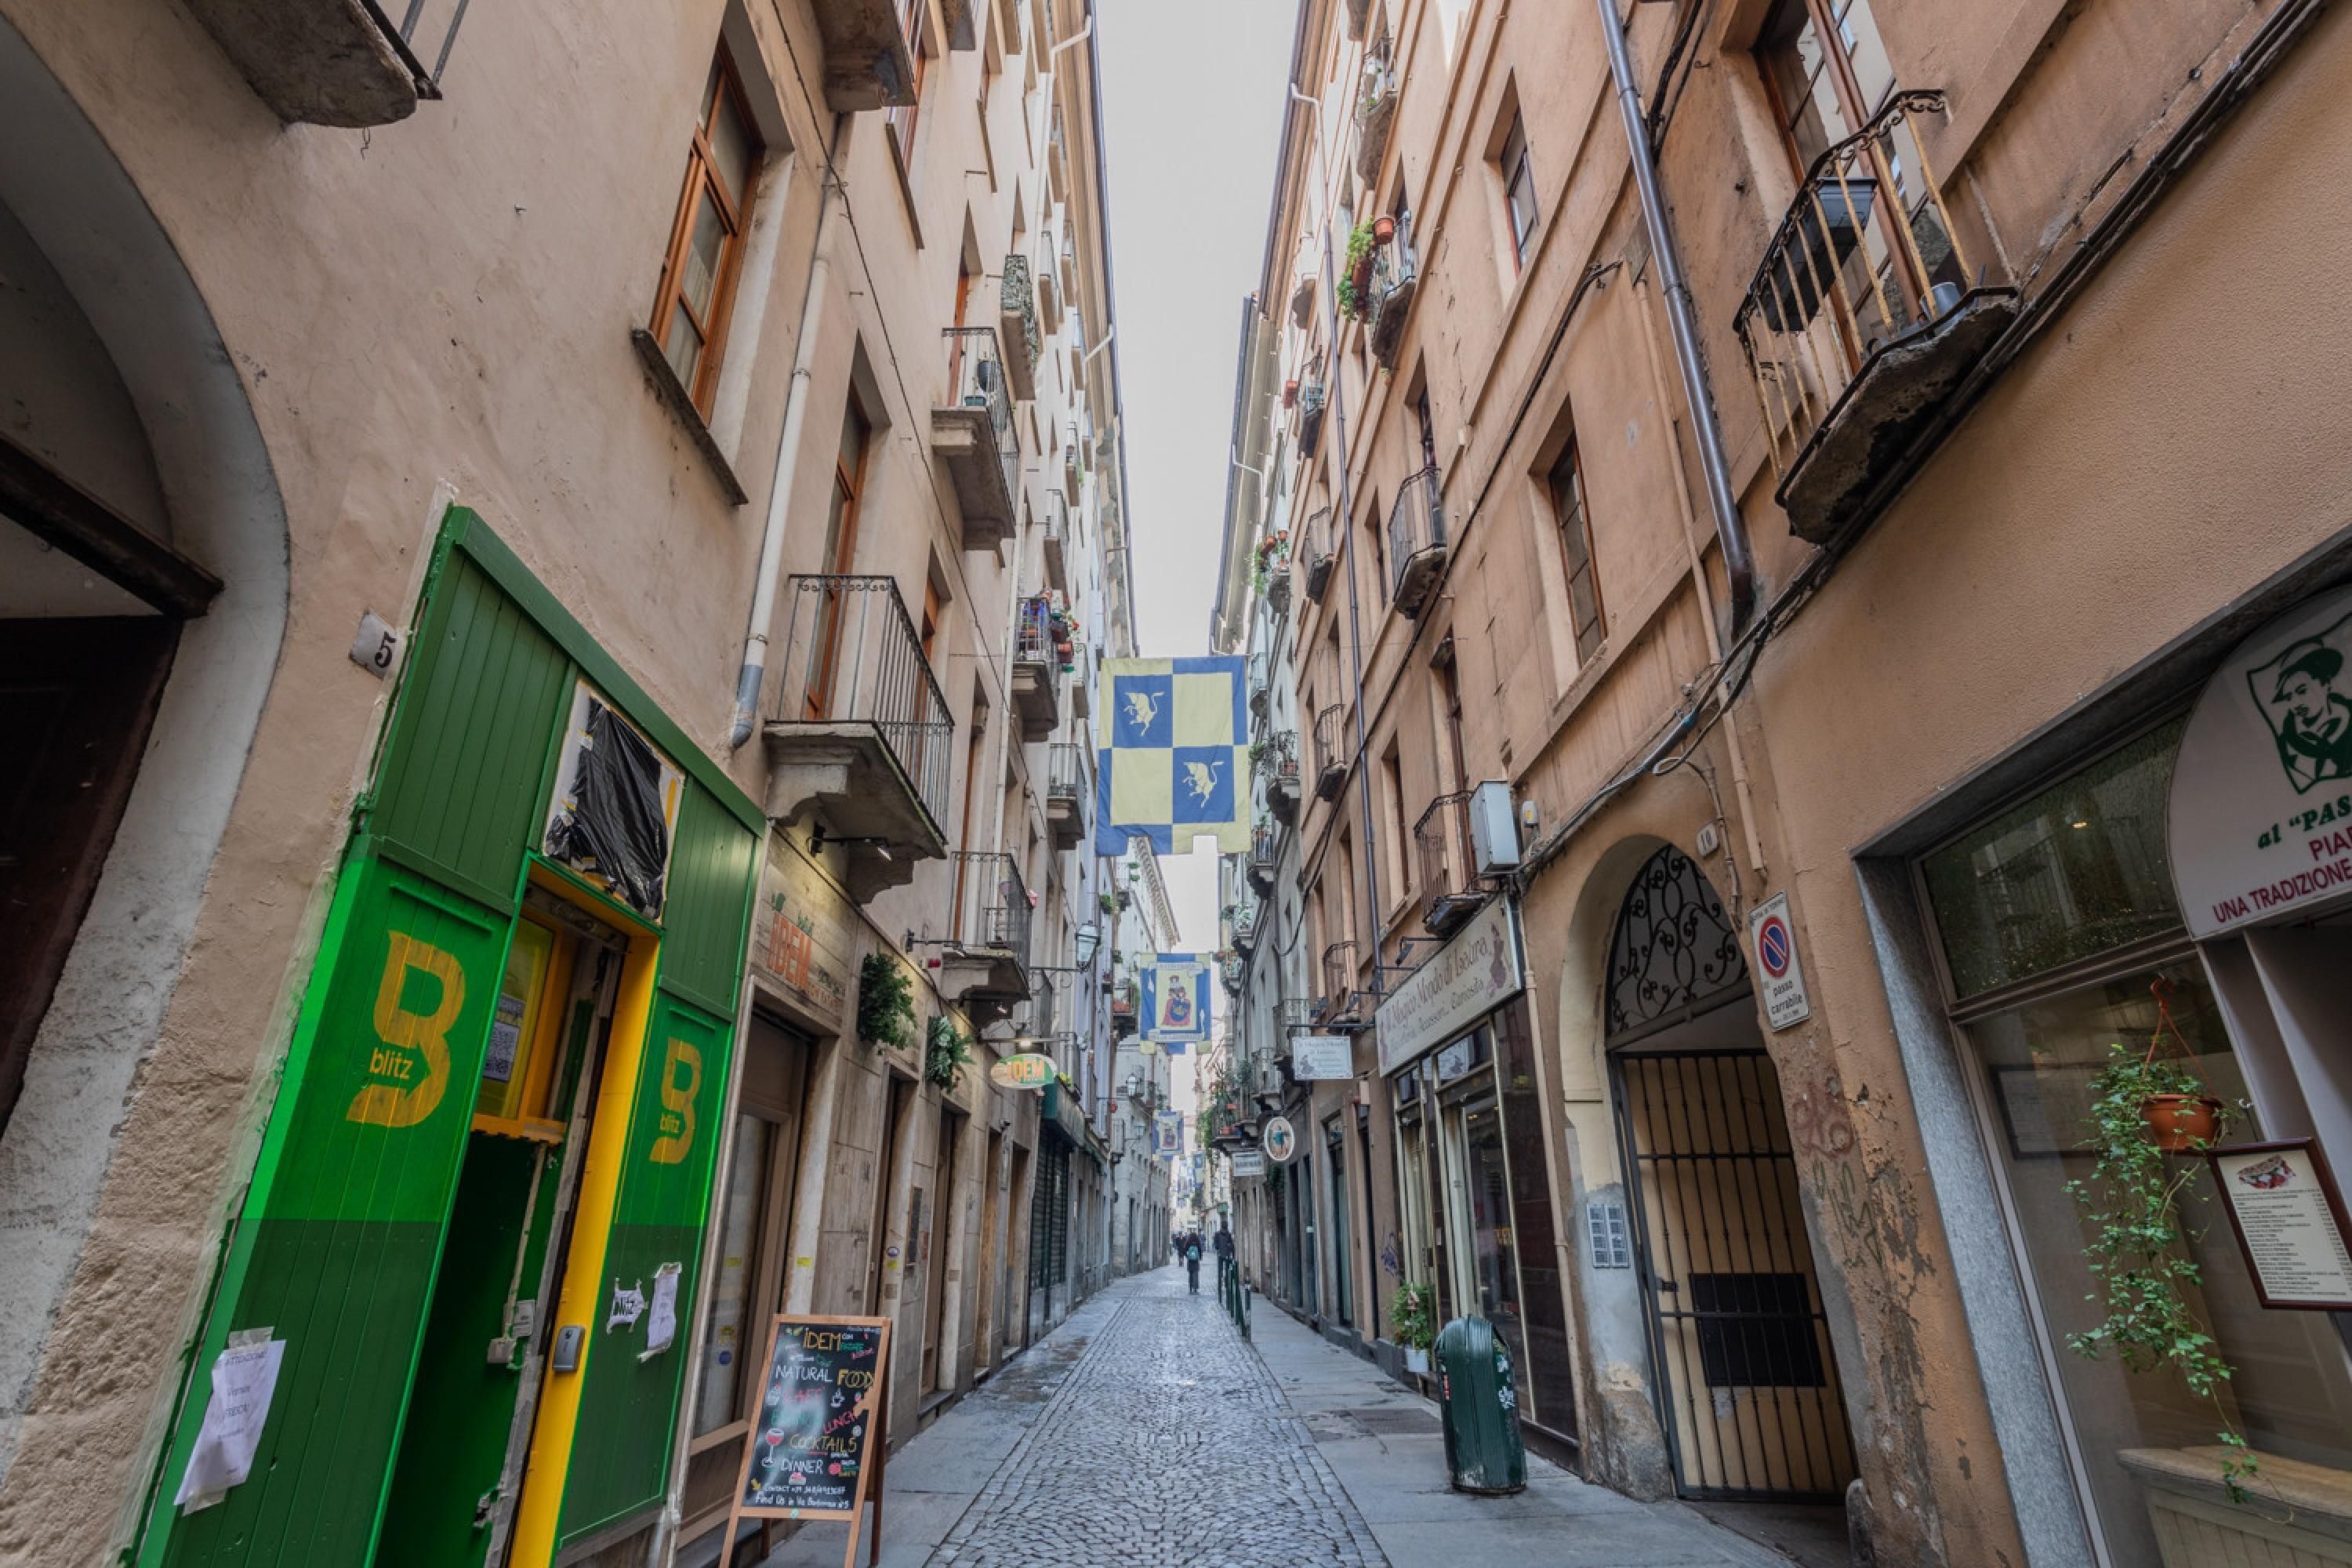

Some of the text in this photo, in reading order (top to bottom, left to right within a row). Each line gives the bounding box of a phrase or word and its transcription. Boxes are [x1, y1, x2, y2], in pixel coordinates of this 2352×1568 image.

[375, 630, 396, 668] 5
[1700, 829, 1712, 851] 10
[2257, 822, 2282, 849] al
[2212, 857, 2352, 924] UNA TRADIZIONE
[1773, 980, 1794, 998] passo
[1771, 993, 1803, 1015] carrabile
[369, 1047, 413, 1080] blitz
[660, 1112, 681, 1134] blitz
[775, 1364, 873, 1388] NATURAL FOOD
[789, 1434, 858, 1453] COCKTAILS
